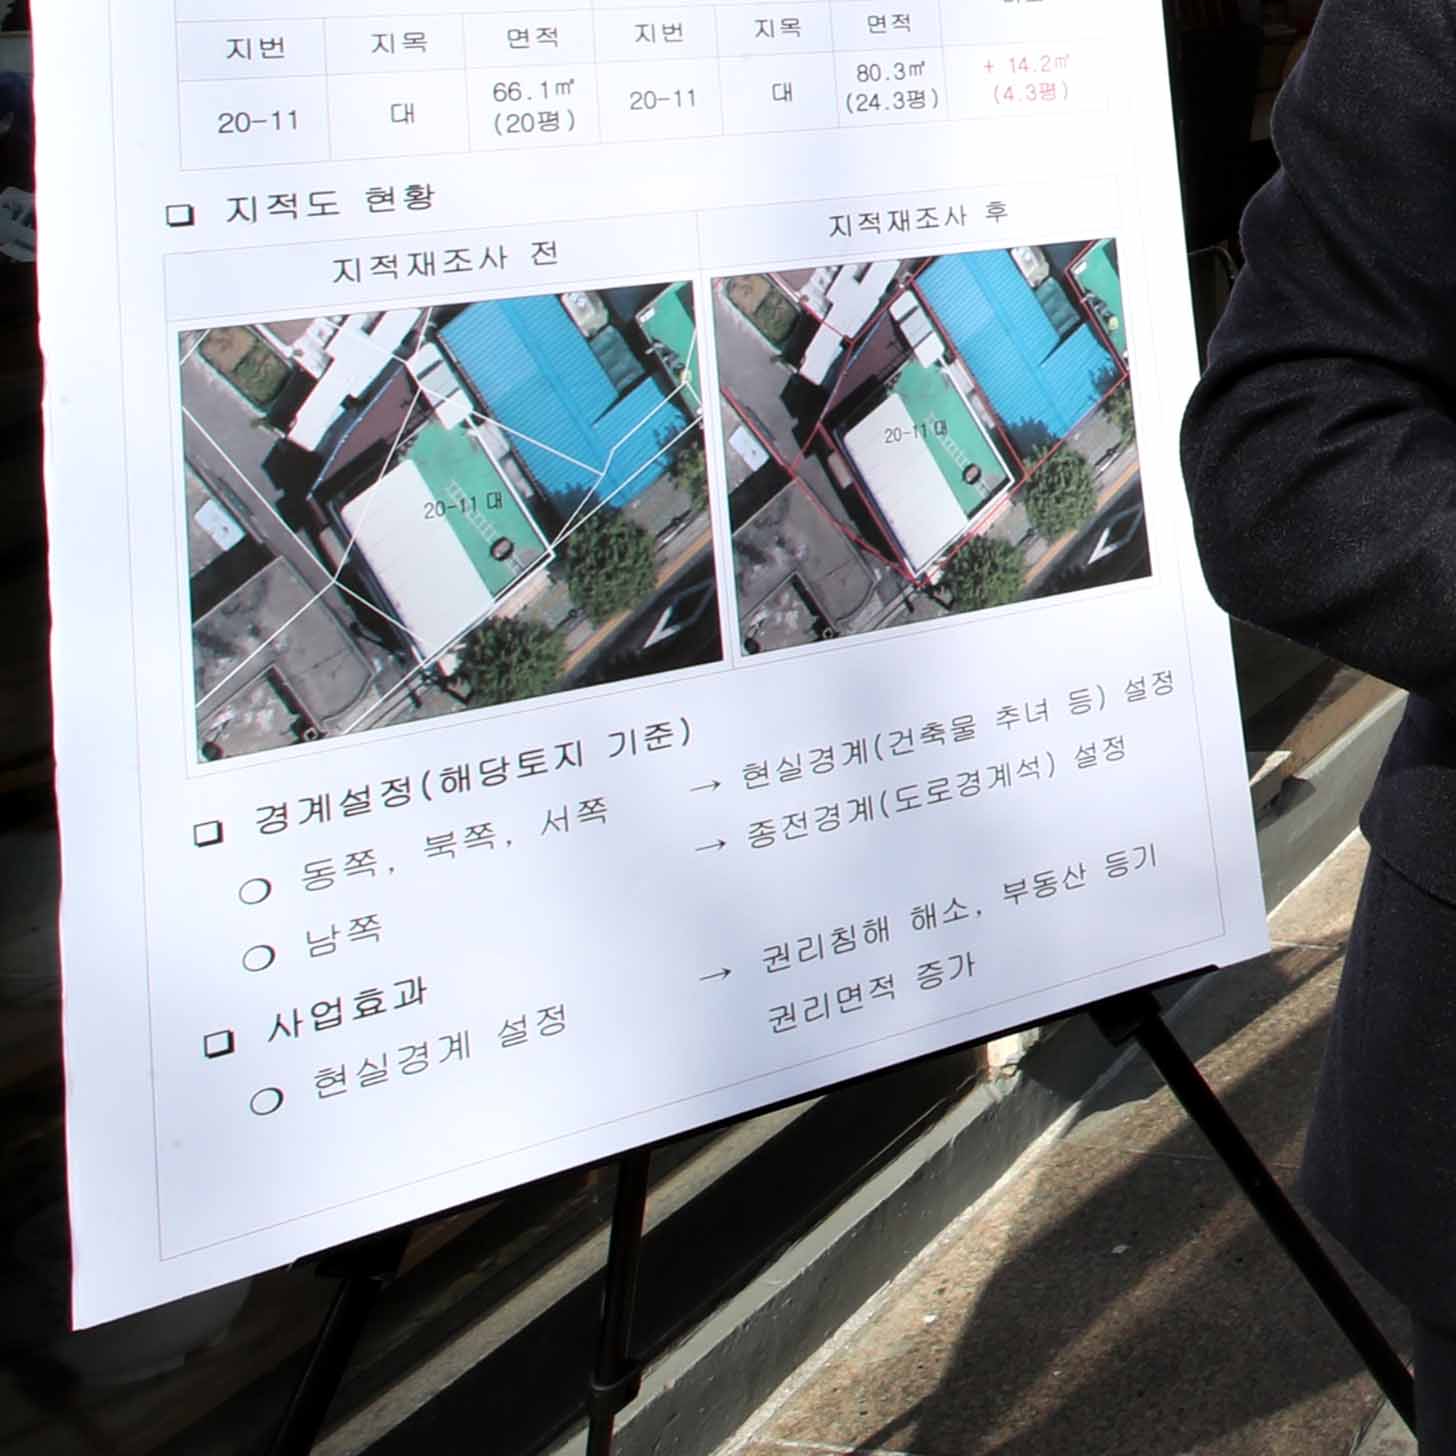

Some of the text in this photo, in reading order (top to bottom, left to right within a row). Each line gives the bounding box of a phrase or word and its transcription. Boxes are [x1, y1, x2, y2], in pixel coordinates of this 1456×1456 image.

[635, 24, 683, 43] 지번
[755, 18, 800, 38] 지목
[867, 14, 910, 34] 면적
[227, 37, 284, 60] 지번
[372, 32, 427, 54] 지목
[507, 28, 557, 49] 면적
[630, 89, 695, 110] 20-11
[772, 83, 792, 101] 대
[846, 88, 938, 114] (24.3평)
[218, 110, 296, 133] 20-11
[391, 104, 414, 124] 대
[494, 109, 574, 136] (20평)
[227, 184, 435, 223] 지적도 현황
[829, 201, 1008, 237] 지적재조사 후
[333, 241, 557, 283] 지적재조사 전
[424, 491, 503, 519] 20-11 대
[742, 670, 1173, 790] 현실경계(건축물 추녀 등) 설정
[255, 717, 689, 835] 경계설정(해당토지 기준)
[747, 736, 1125, 849] 종전경계(도로경계석) 설정
[302, 797, 607, 891] 동쪽, 북쪽, 서쪽
[763, 843, 1156, 973] 권리침해 해소, 부동산 등기
[306, 914, 382, 958] 남쪽
[769, 952, 975, 1033] 권리면적 증가
[268, 976, 427, 1042] 사업효과
[314, 1004, 565, 1099] 현실경계 설정
